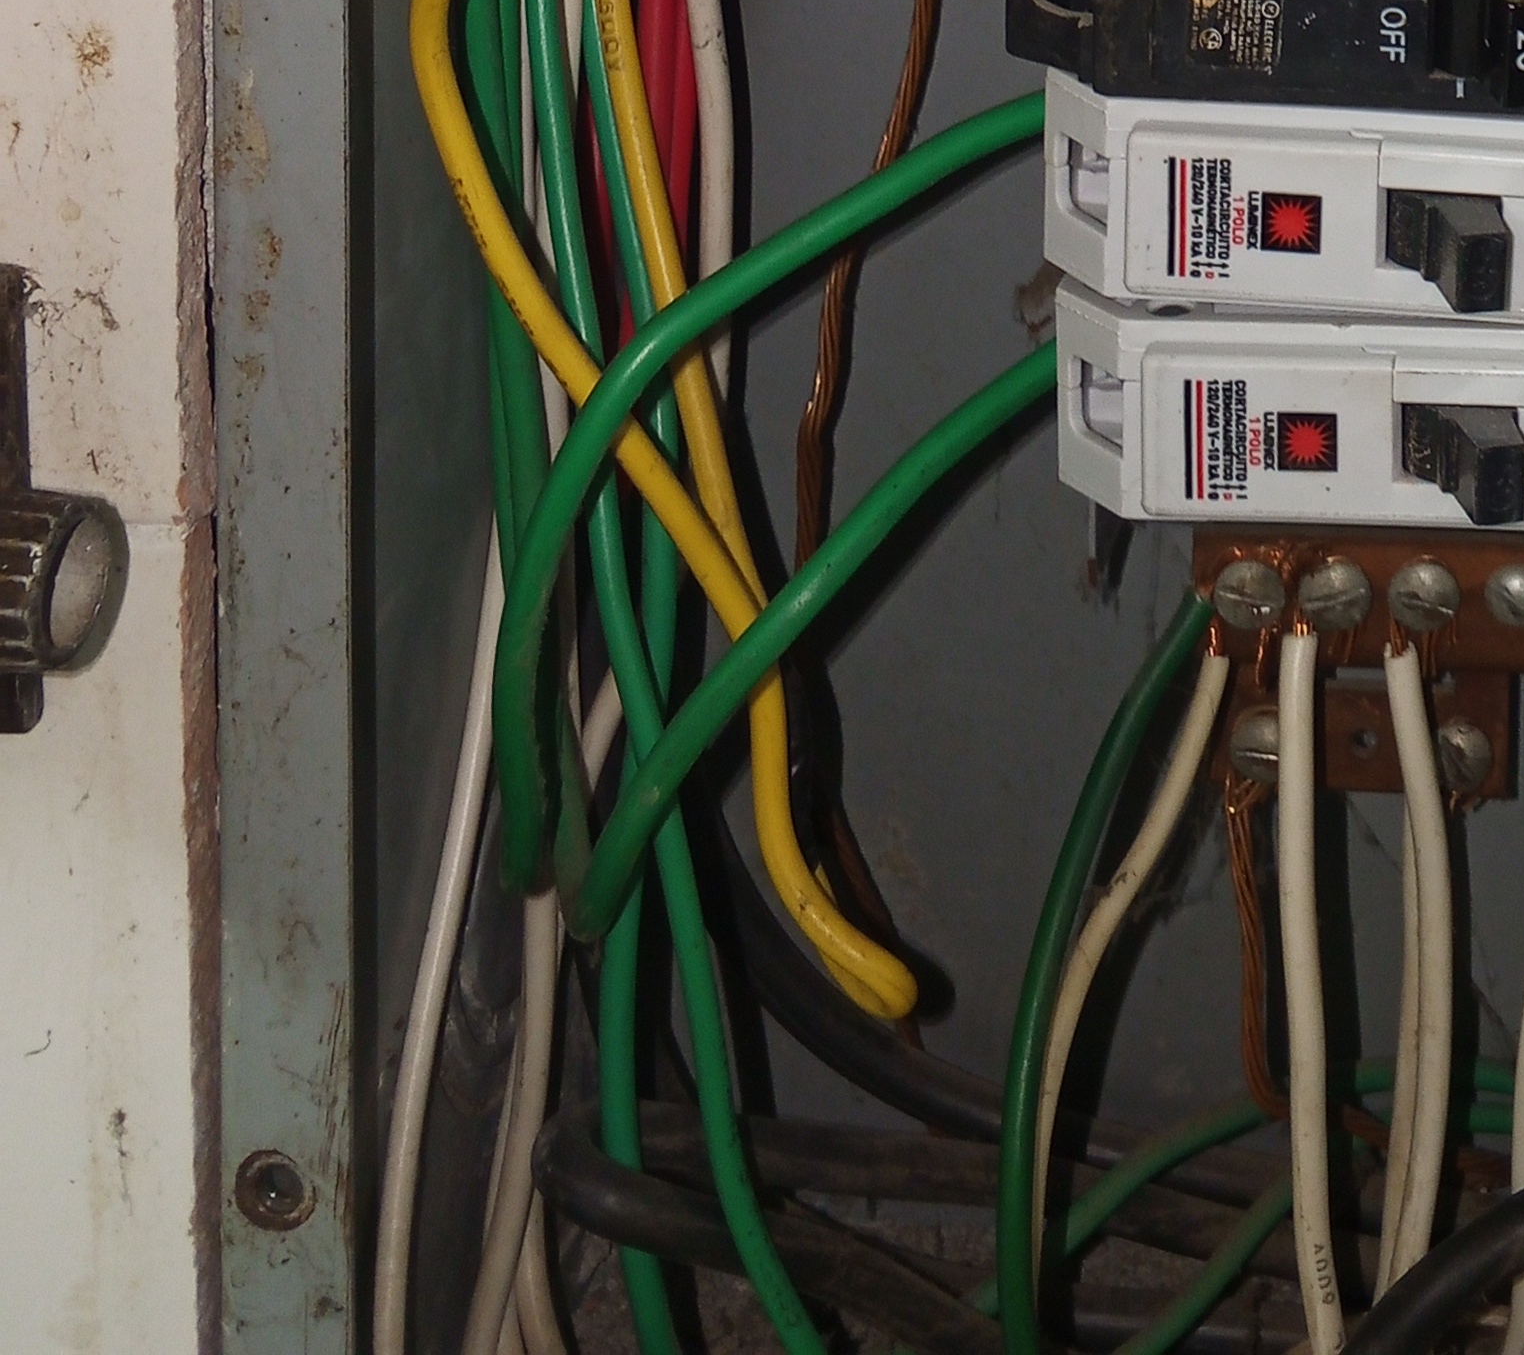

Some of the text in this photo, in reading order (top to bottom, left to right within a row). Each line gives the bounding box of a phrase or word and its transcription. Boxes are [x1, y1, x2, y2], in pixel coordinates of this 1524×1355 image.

[1379, 7, 1407, 63] OFF
[1191, 157, 1205, 205] 120/240
[1218, 159, 1231, 260] CORTACIRCUITO
[1232, 207, 1244, 245] POLO
[1206, 378, 1221, 428] 120/240
[1234, 379, 1247, 481] CORTACIRCUITO
[1249, 428, 1261, 466] POLO
[1314, 1243, 1336, 1304] 600V
